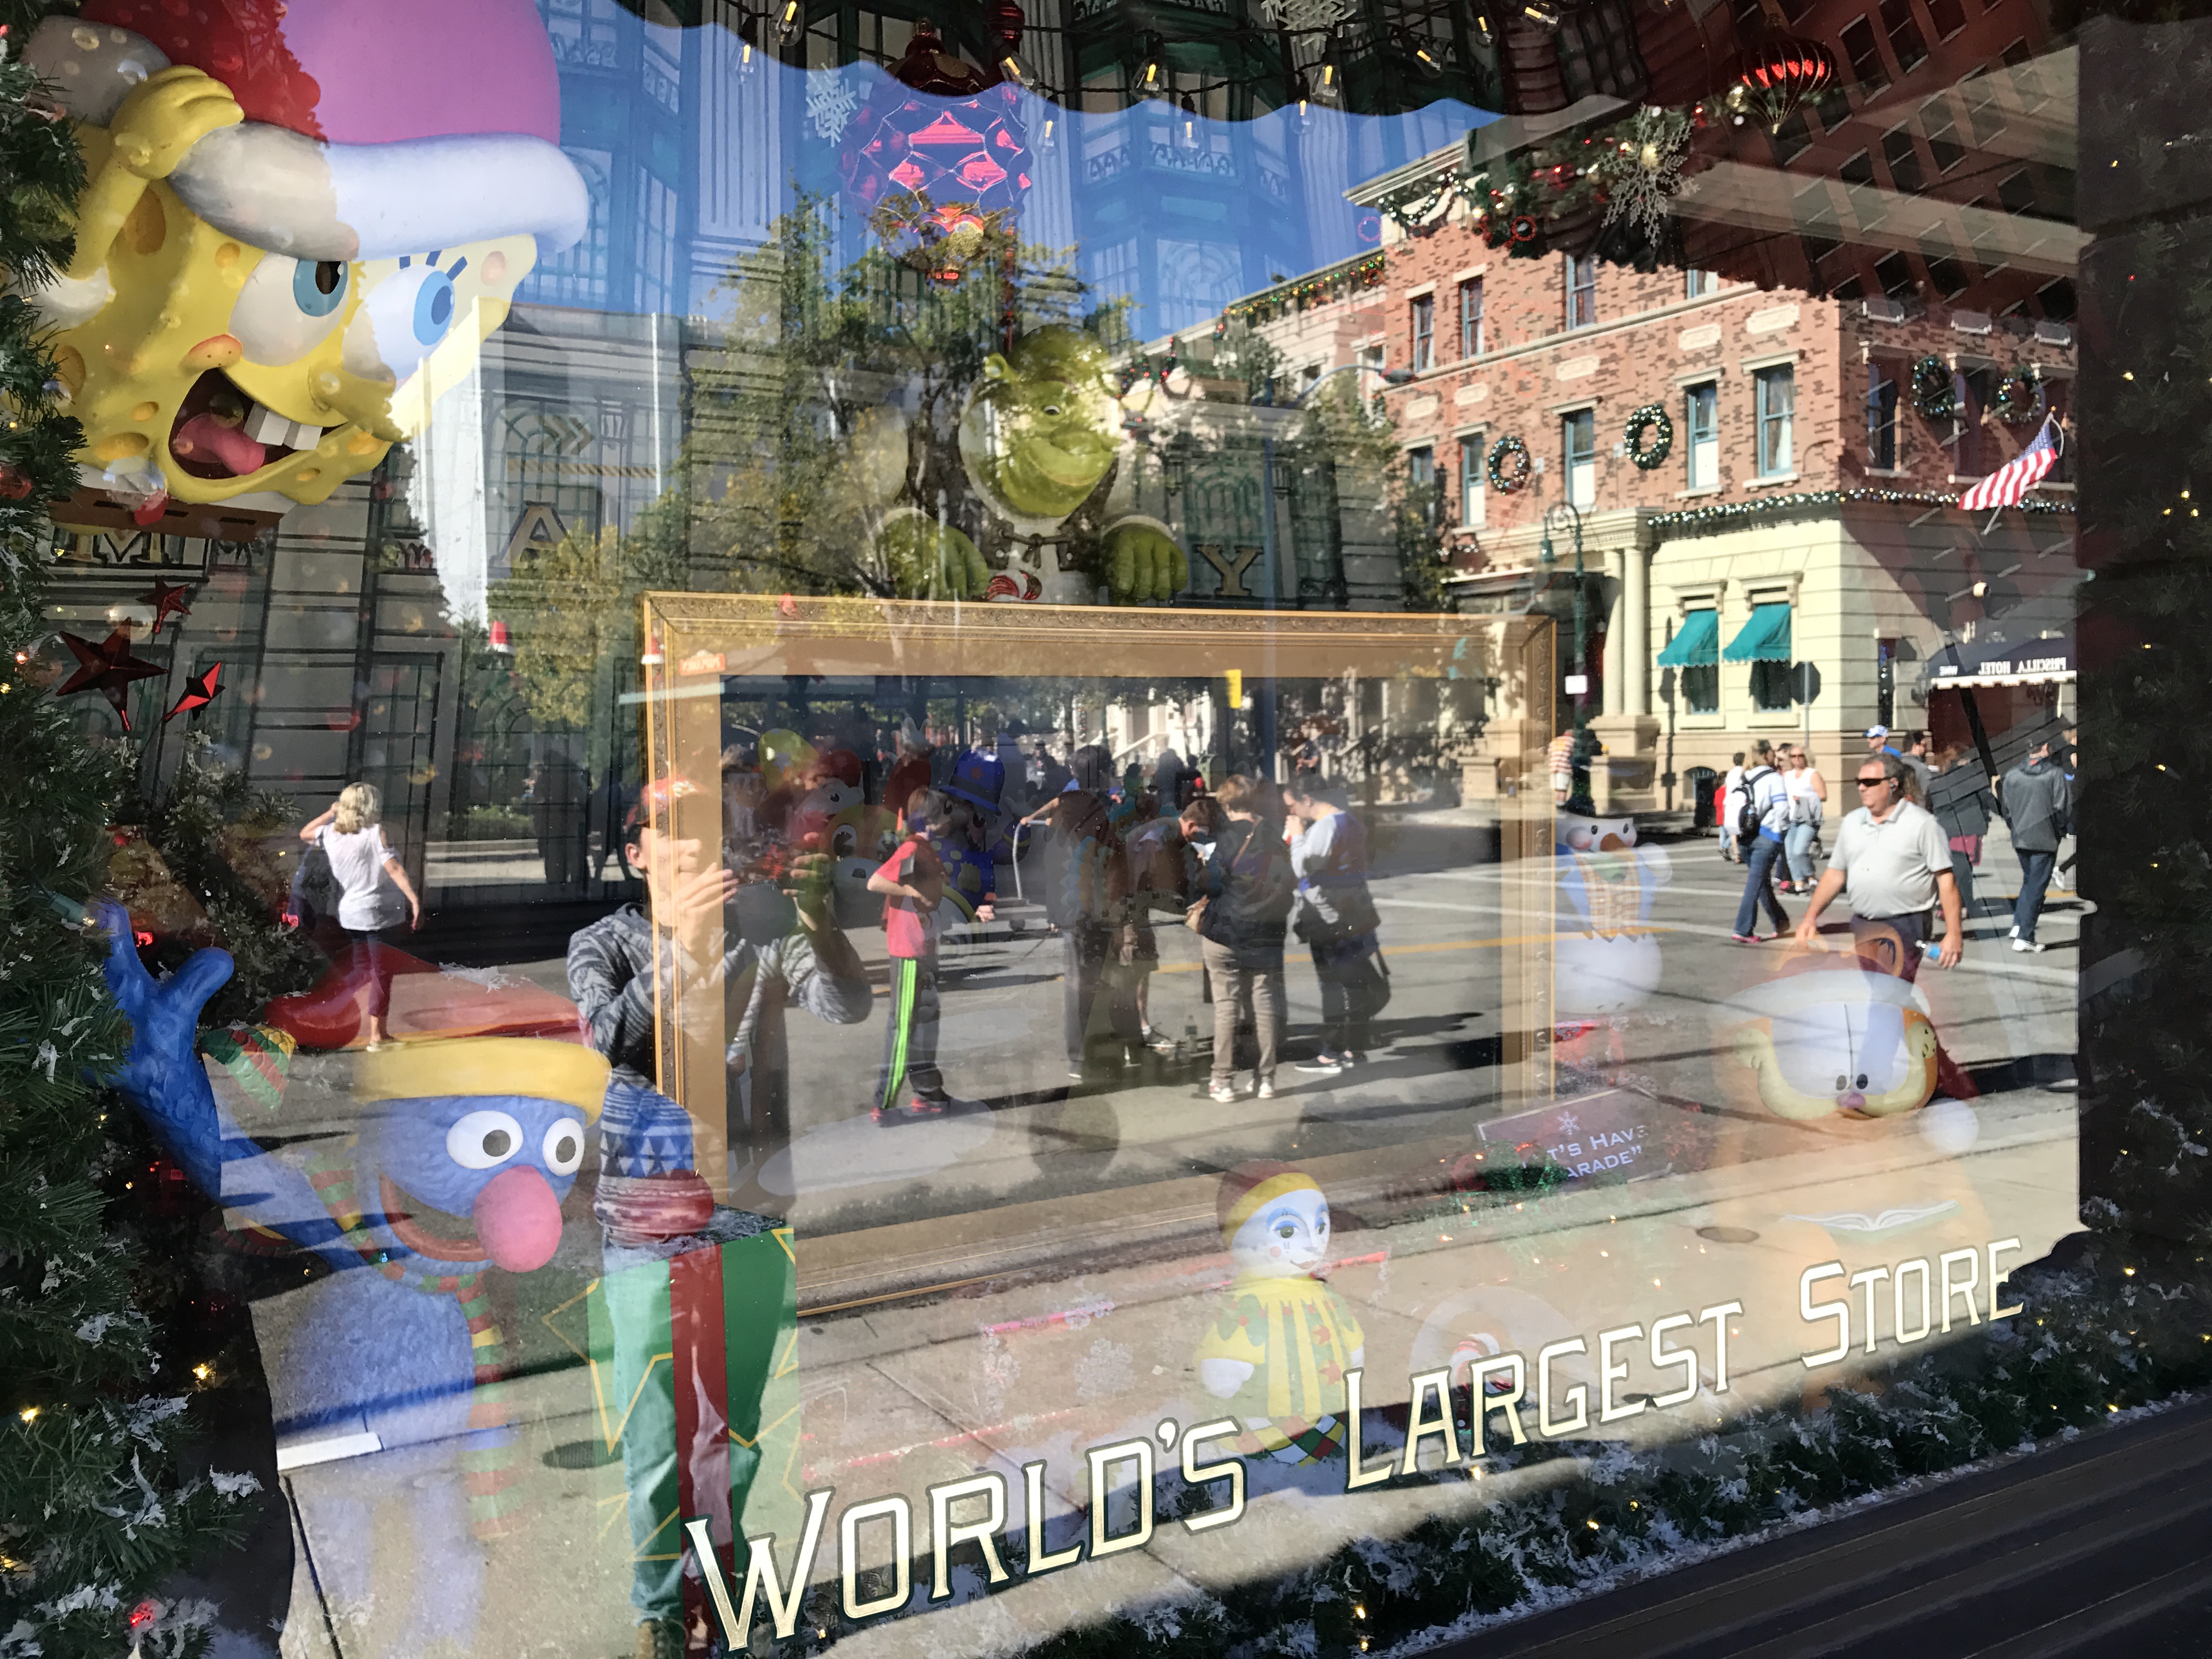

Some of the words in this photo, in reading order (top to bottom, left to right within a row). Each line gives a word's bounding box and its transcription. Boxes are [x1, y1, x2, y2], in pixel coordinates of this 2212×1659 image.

[1567, 1144, 1642, 1177] ARADE”
[684, 1415, 1248, 1652] WORLD’S
[1344, 1298, 1745, 1494] LARGEST
[1799, 1237, 2024, 1369] STORE
